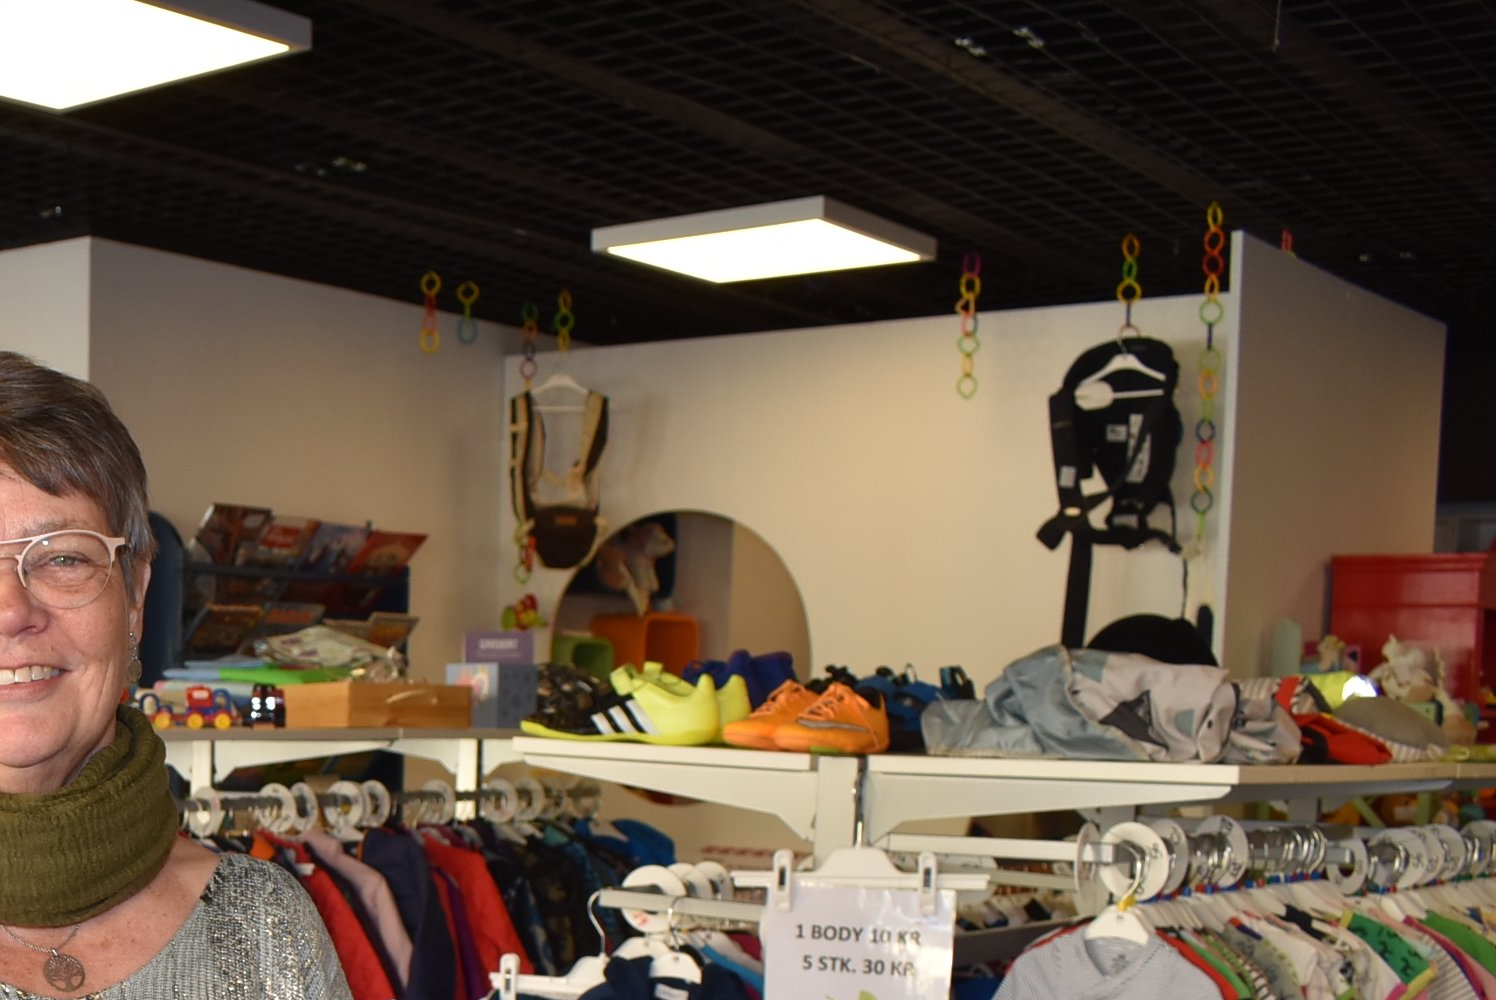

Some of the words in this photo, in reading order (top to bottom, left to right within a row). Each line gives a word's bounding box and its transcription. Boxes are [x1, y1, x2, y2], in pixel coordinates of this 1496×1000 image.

[796, 924, 805, 939] 1
[811, 924, 864, 943] BODY
[870, 928, 892, 944] 10
[802, 954, 813, 971] 5
[817, 955, 856, 973] STK.
[862, 958, 886, 975] 30
